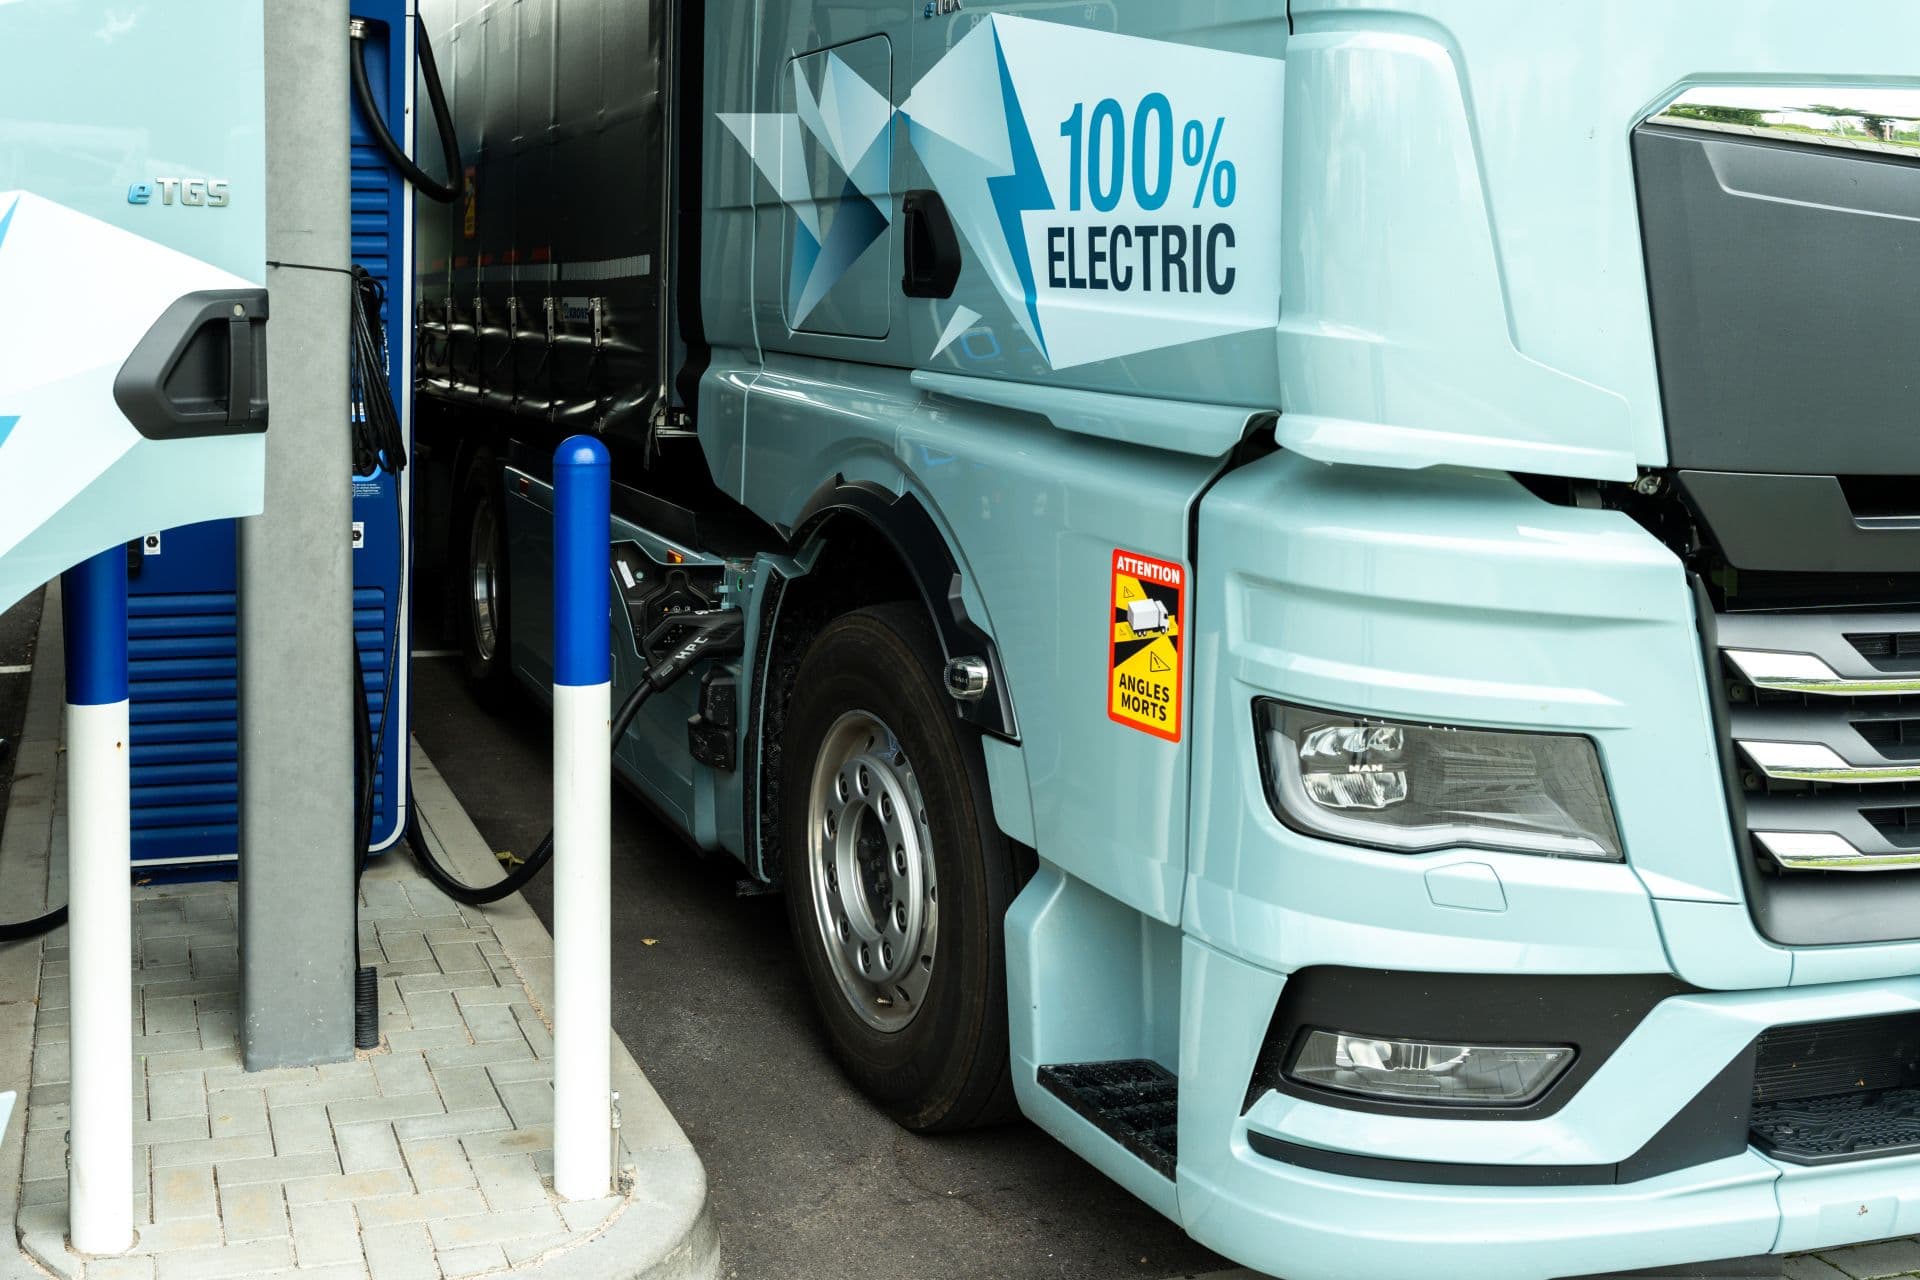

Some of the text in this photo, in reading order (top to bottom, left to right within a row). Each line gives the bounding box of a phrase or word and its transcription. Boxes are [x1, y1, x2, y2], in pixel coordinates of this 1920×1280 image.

[1060, 92, 1236, 212] 100%
[128, 177, 230, 208] eTGS
[1048, 223, 1236, 295] ELECTRIC
[1117, 556, 1181, 585] ATTENTION
[674, 636, 709, 660] HPC
[1119, 673, 1170, 703] ANGLES
[1121, 692, 1167, 722] MORTS
[1348, 764, 1383, 772] MAN
